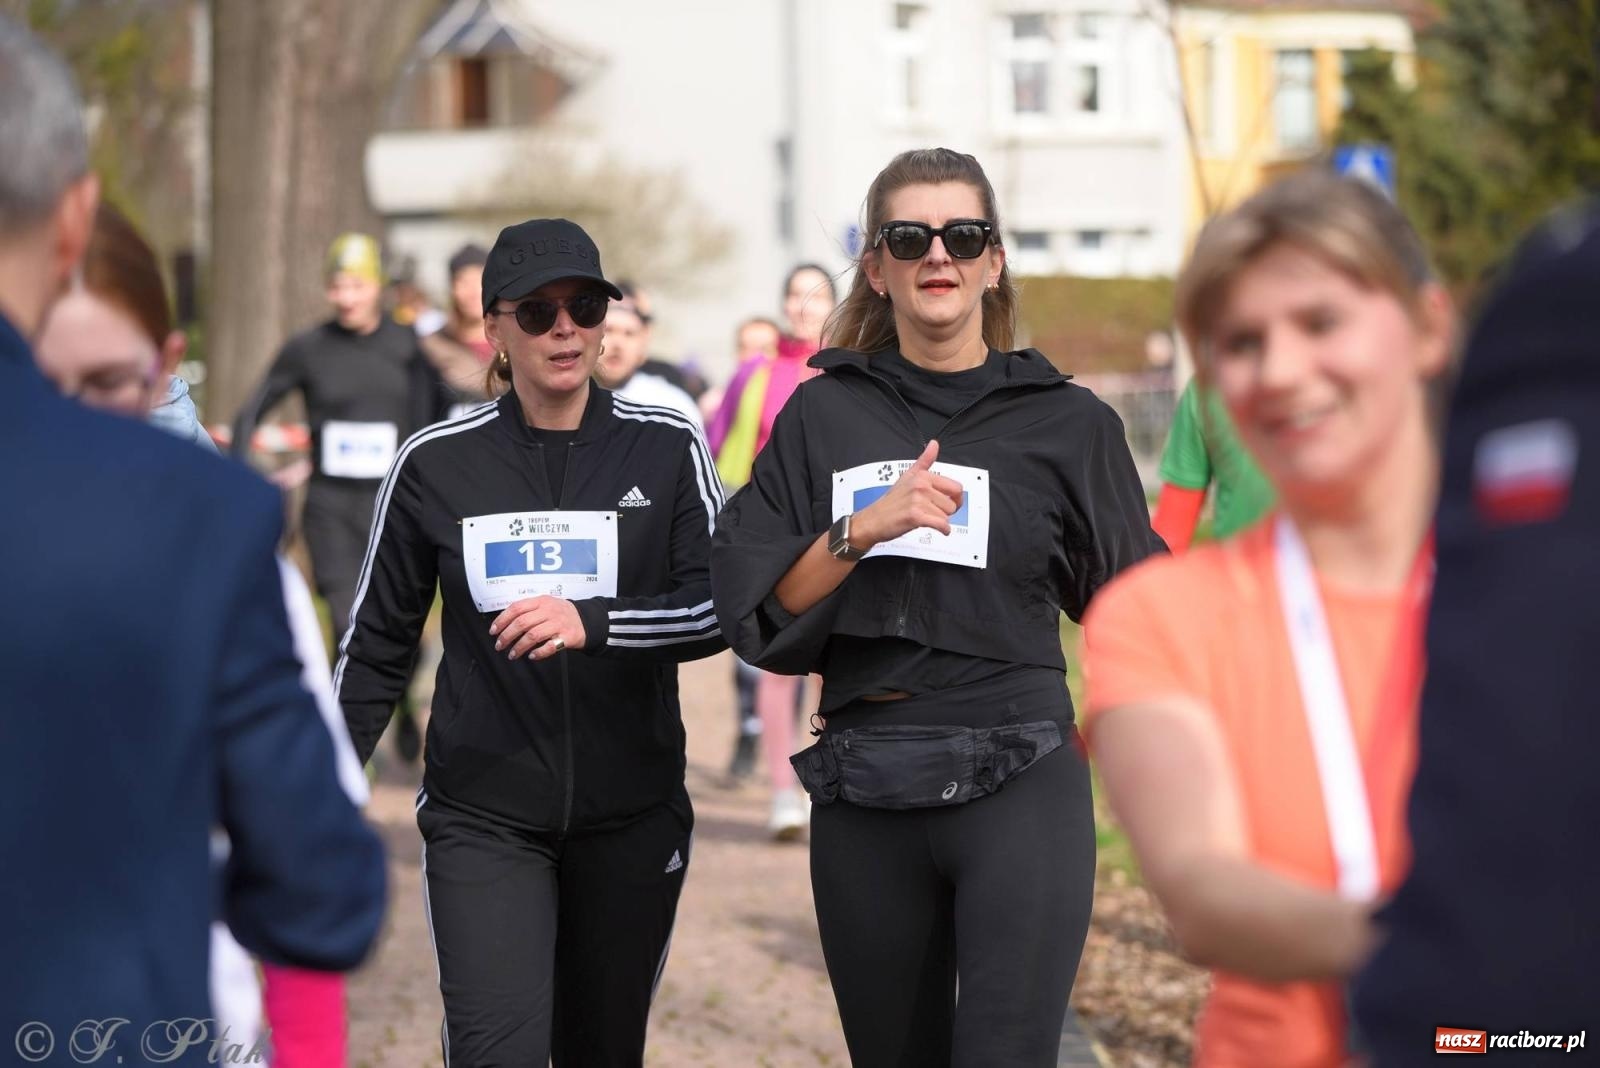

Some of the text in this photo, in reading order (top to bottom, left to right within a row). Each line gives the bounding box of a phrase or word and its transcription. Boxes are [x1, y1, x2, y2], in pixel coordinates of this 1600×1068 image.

[618, 499, 651, 507] adidas
[528, 523, 570, 534] WILCZYM
[518, 540, 563, 572] 13
